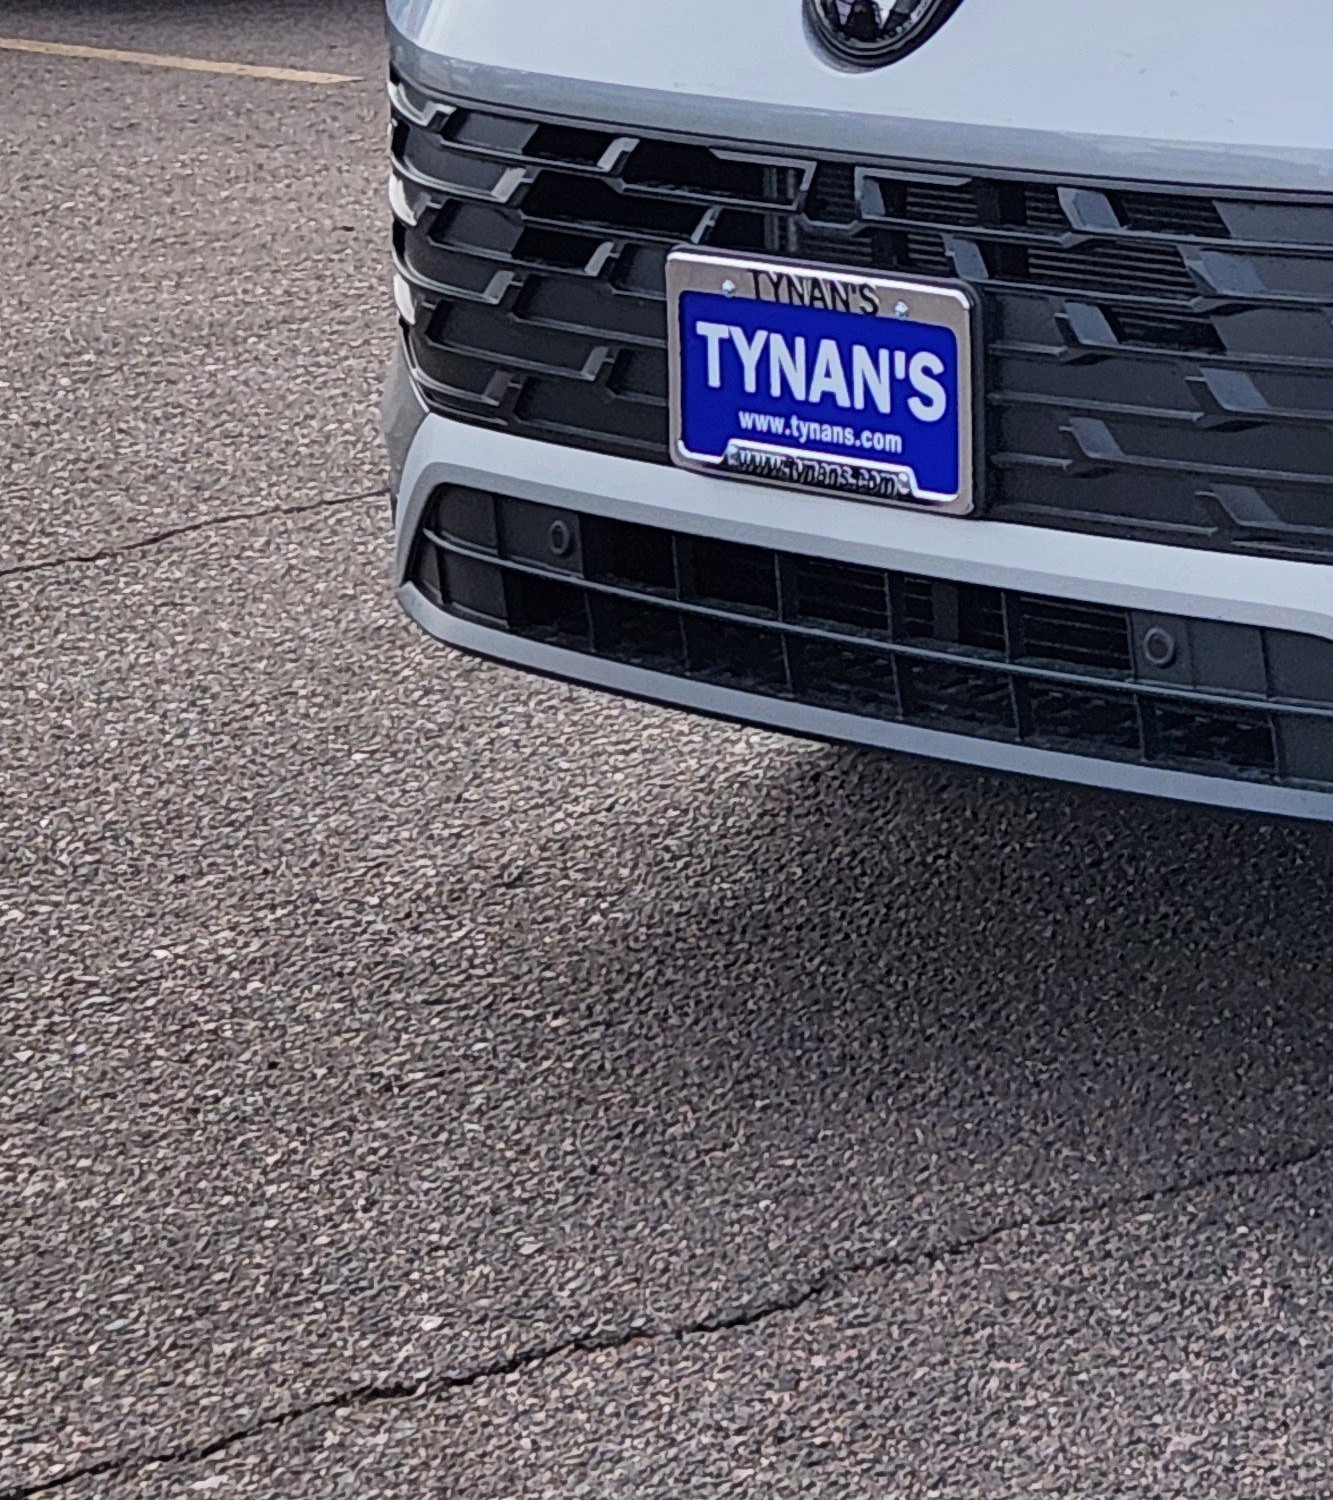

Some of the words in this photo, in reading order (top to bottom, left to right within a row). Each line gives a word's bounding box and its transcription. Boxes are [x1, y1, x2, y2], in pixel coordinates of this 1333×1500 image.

[748, 269, 880, 316] TYNAN'S
[696, 321, 947, 423] TYNAN'S
[739, 410, 902, 453] www.tynans.com
